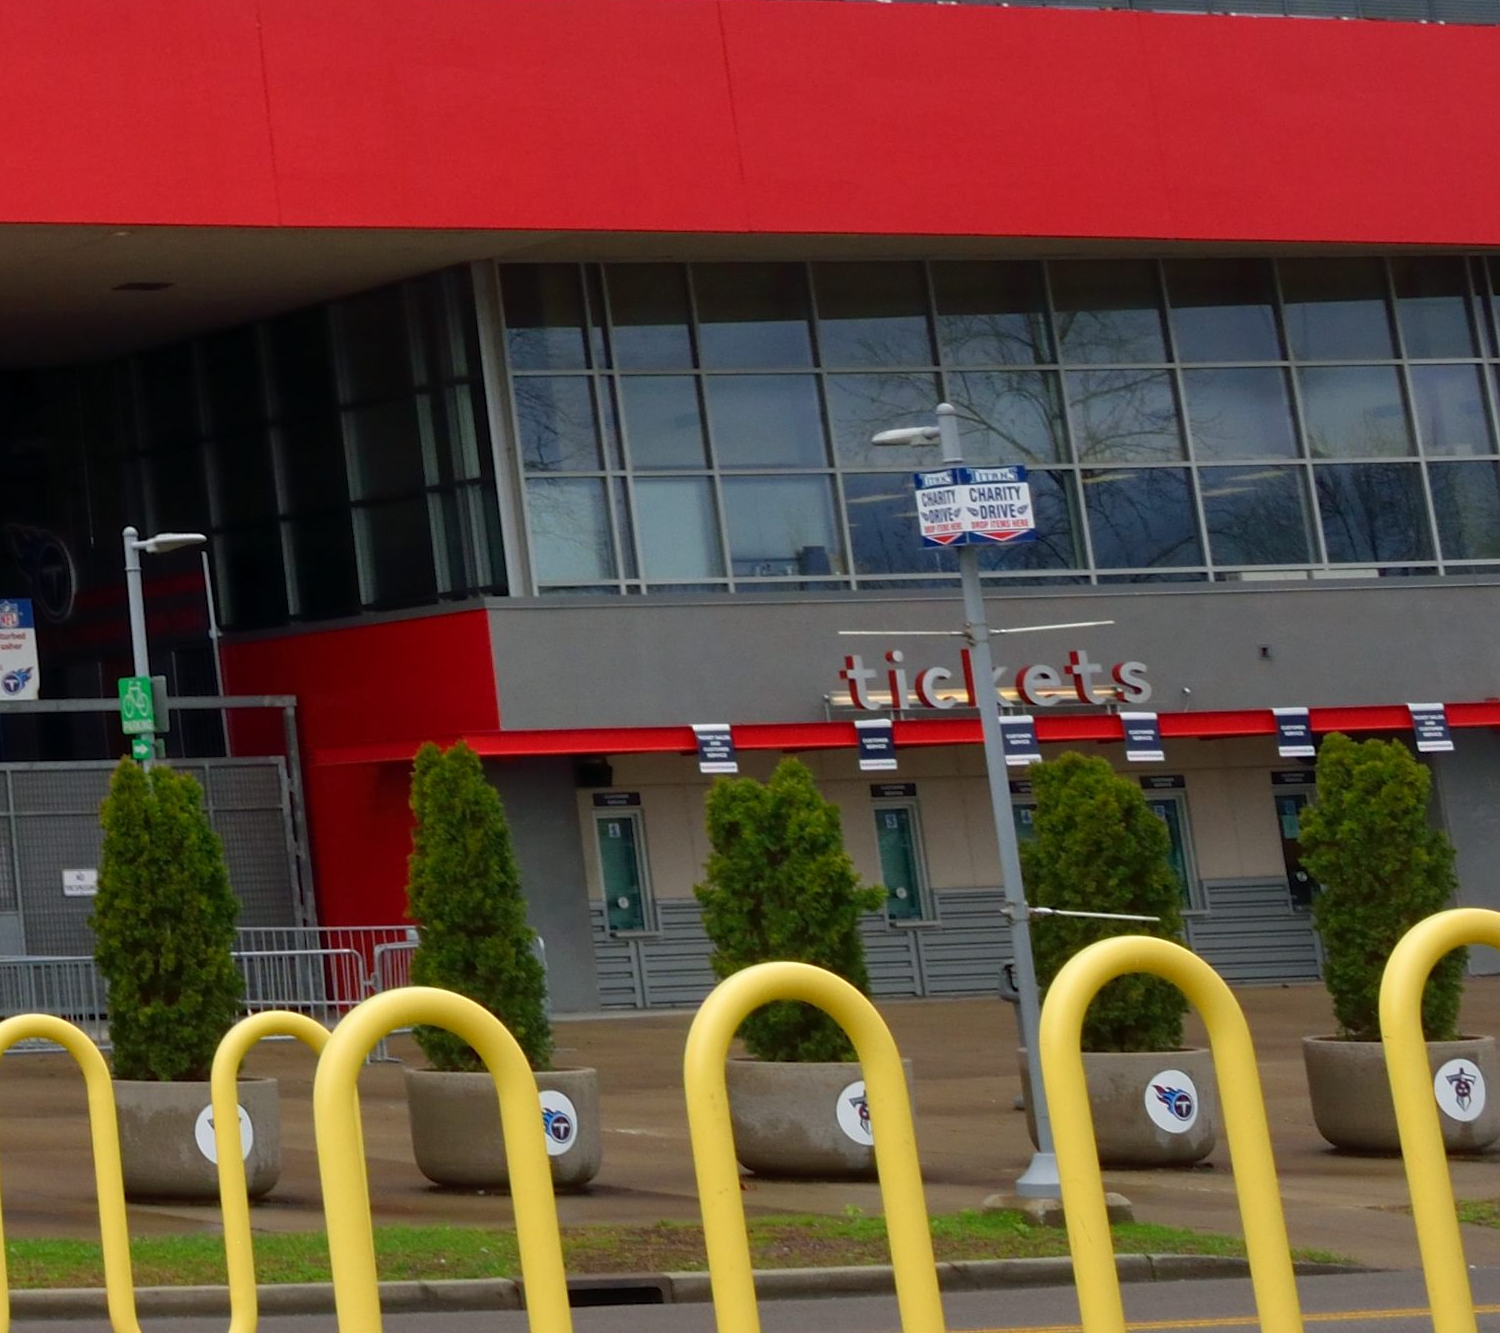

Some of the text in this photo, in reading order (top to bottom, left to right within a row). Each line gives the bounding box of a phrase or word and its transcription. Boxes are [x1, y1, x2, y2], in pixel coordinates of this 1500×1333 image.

[921, 489, 956, 507] CHARITY
[969, 486, 1021, 502] CHARITY
[928, 507, 954, 523] DRIVE
[981, 504, 1017, 520] DRIVE
[971, 518, 1029, 529] DROP ITEMS HERE
